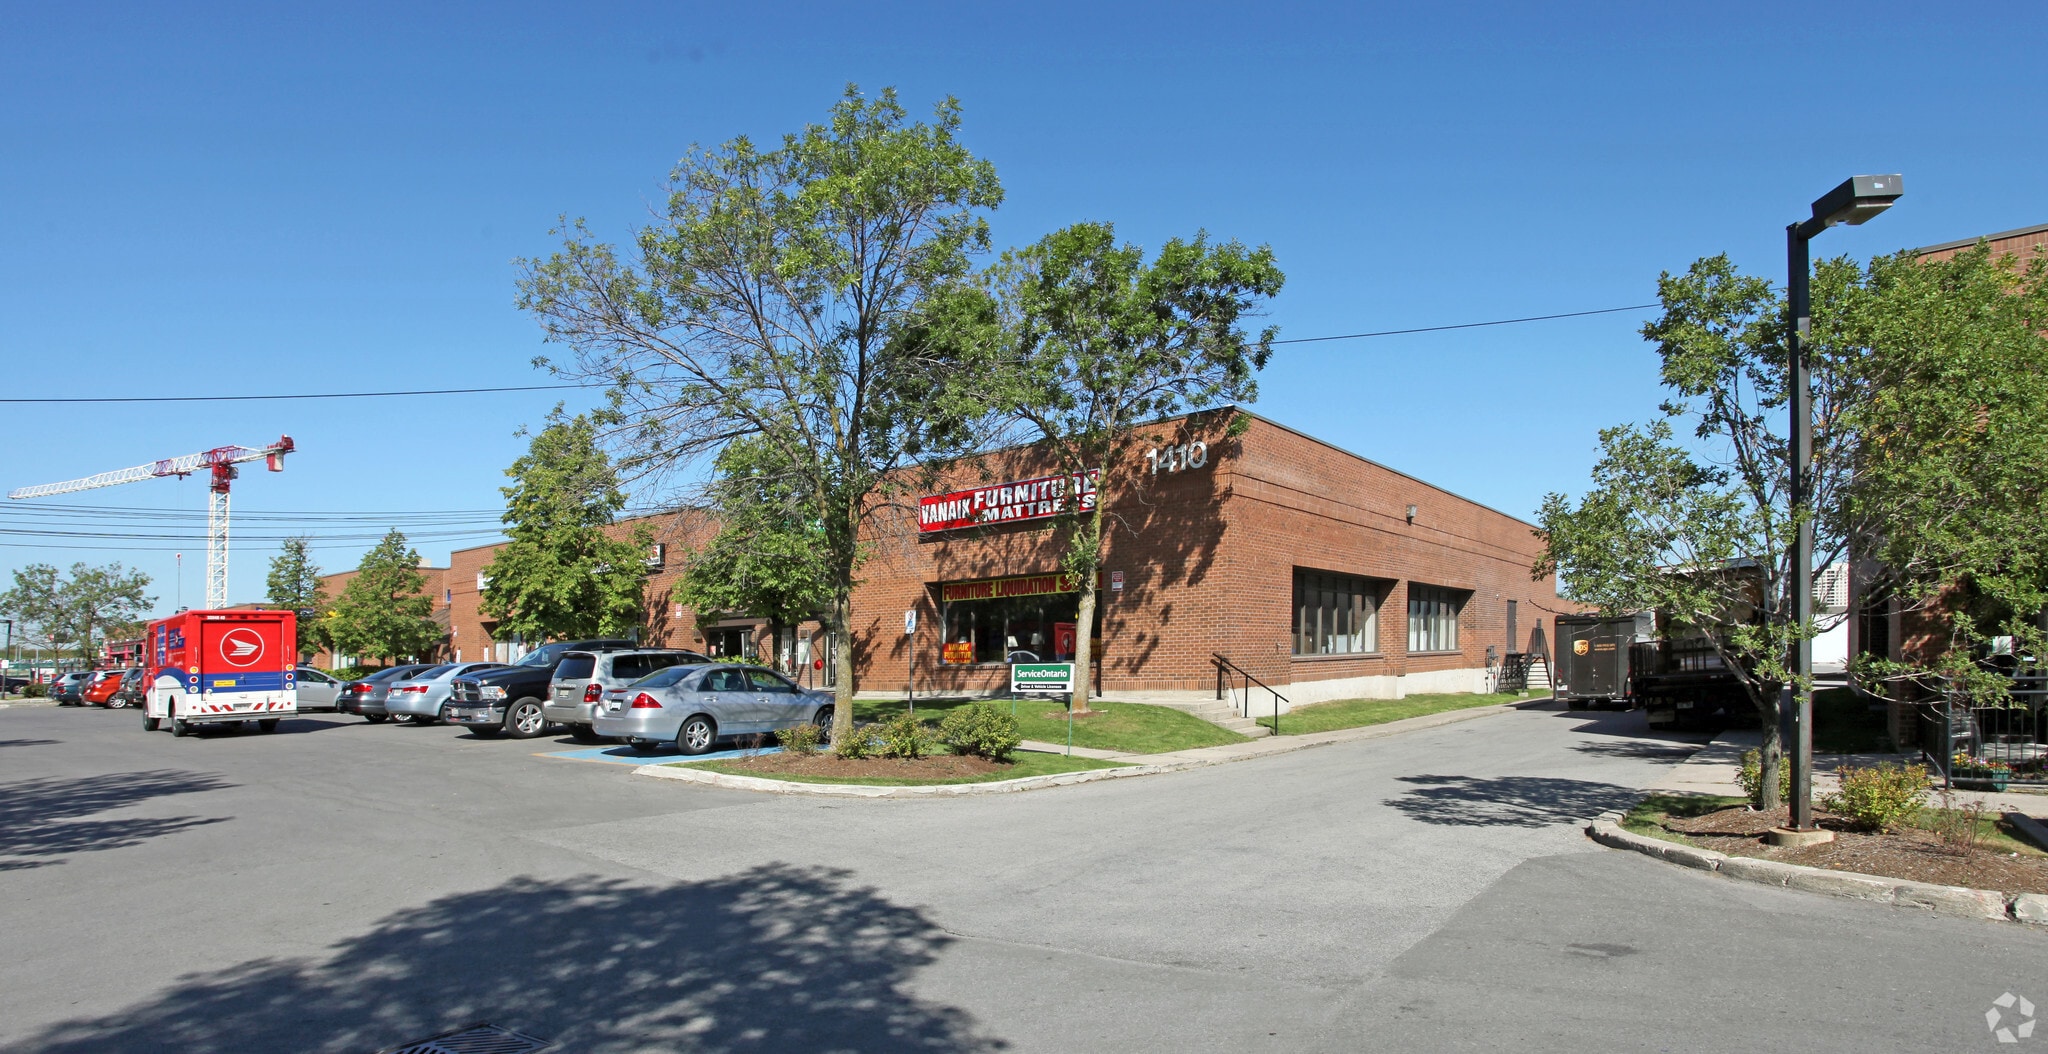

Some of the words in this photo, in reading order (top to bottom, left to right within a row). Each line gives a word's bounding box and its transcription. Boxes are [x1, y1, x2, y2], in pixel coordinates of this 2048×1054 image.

[1146, 441, 1207, 475] 1410
[921, 498, 971, 524] VANAIK
[982, 494, 1097, 522] MATTRES
[943, 582, 993, 601] FURNITURE
[995, 576, 1057, 598] LIQUIDATION
[1017, 669, 1068, 678] ServiceOntario
